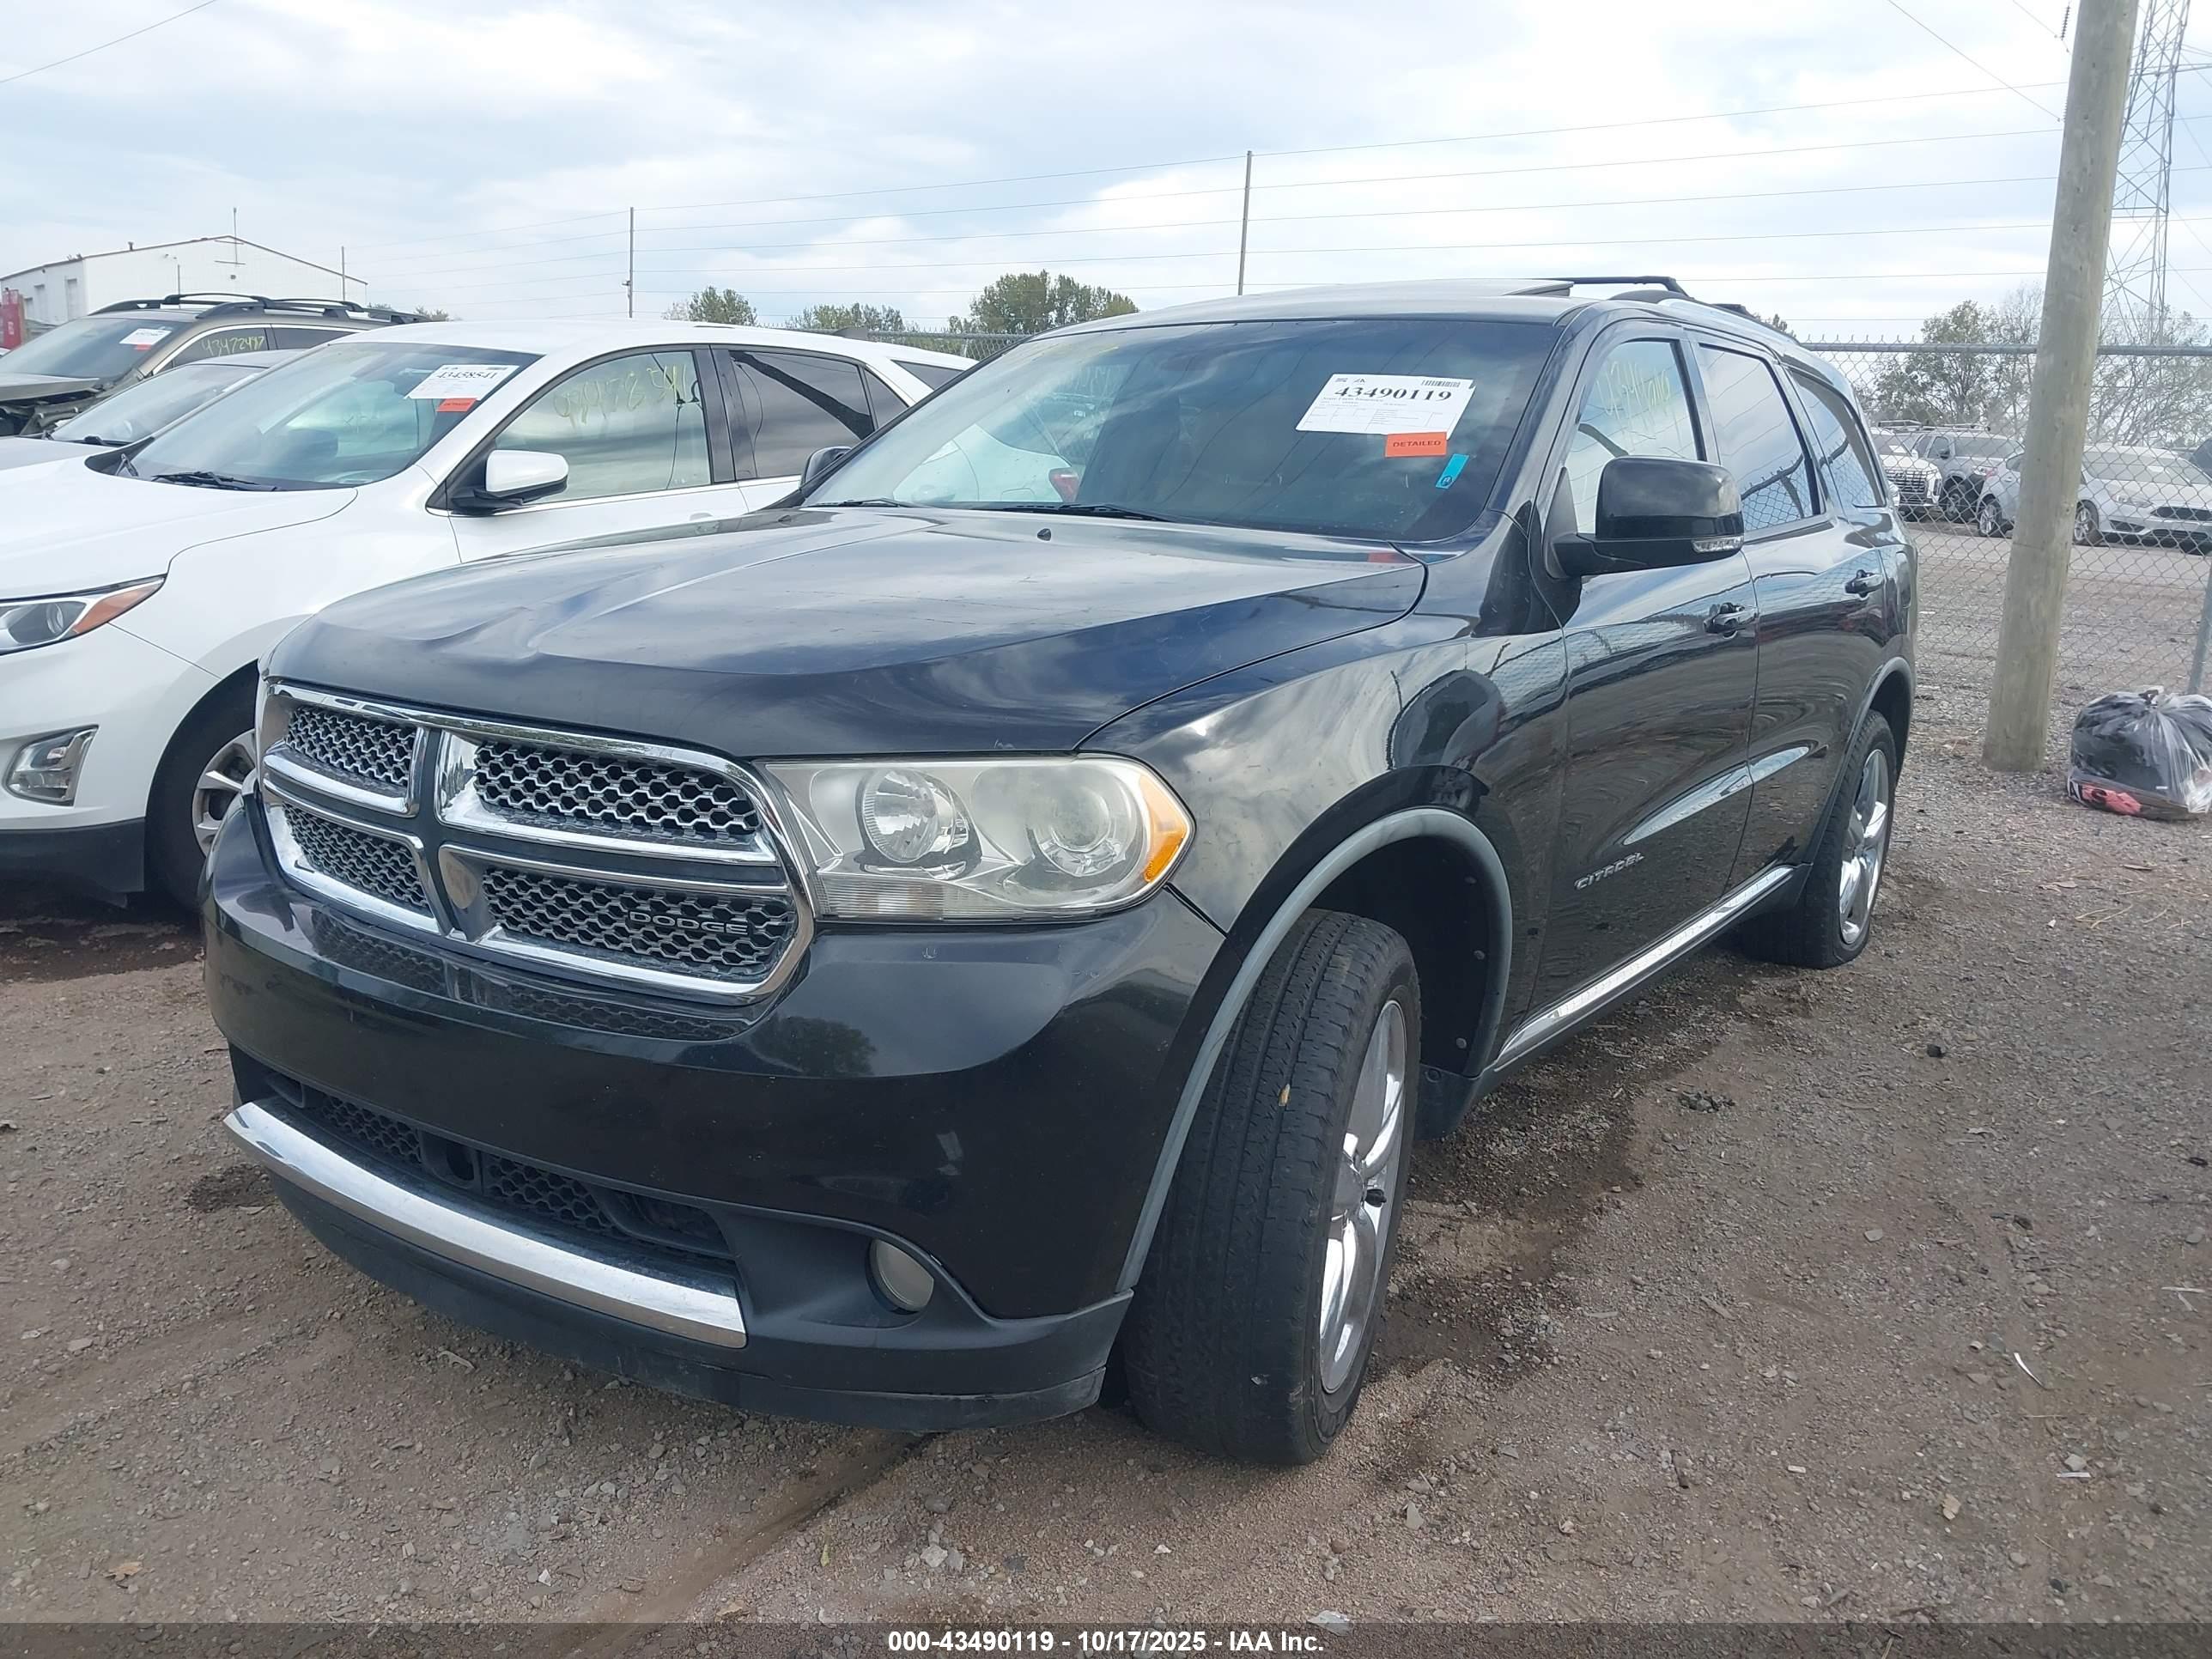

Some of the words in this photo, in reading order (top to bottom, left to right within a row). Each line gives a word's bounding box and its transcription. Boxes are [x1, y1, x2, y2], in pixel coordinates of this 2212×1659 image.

[1334, 386, 1452, 403] 43490119
[1574, 851, 1645, 890] CITADEL
[629, 910, 749, 936] DODGE
